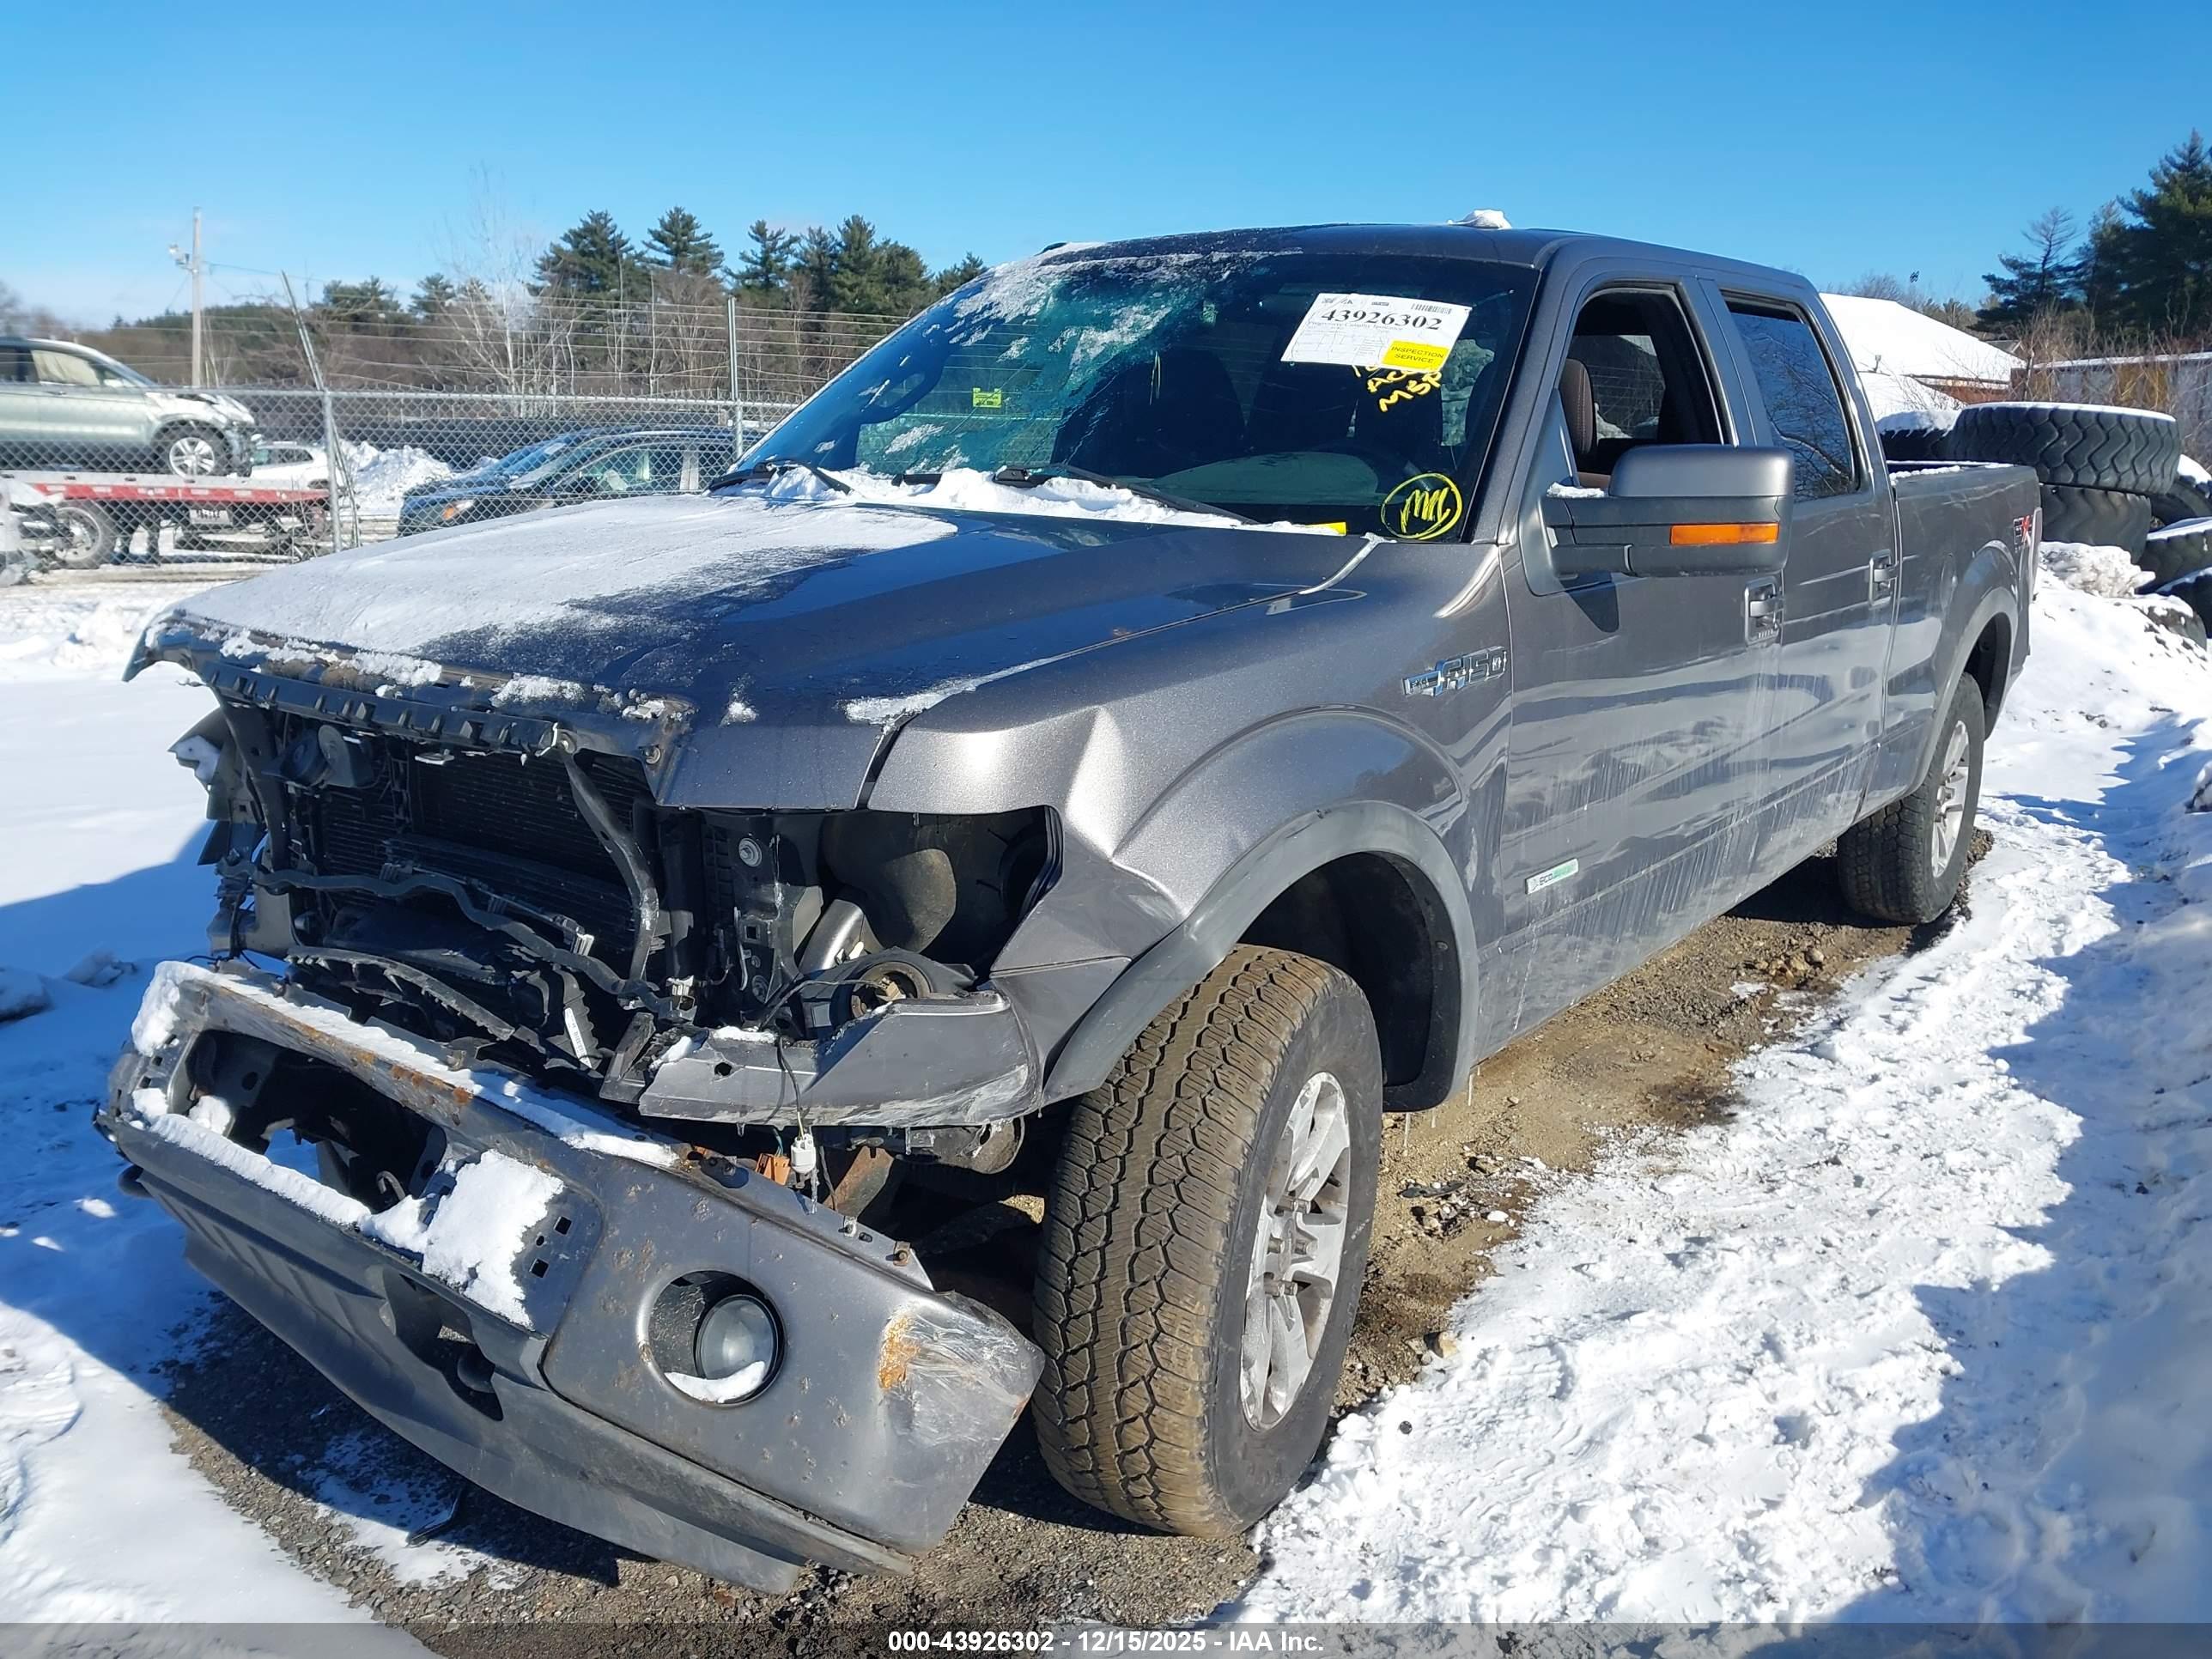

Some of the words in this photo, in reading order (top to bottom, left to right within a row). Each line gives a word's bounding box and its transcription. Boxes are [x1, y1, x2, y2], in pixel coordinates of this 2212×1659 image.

[1322, 308, 1443, 331] 43926302
[1391, 346, 1444, 358] INSPECTION
[1395, 354, 1434, 363] SERVICE
